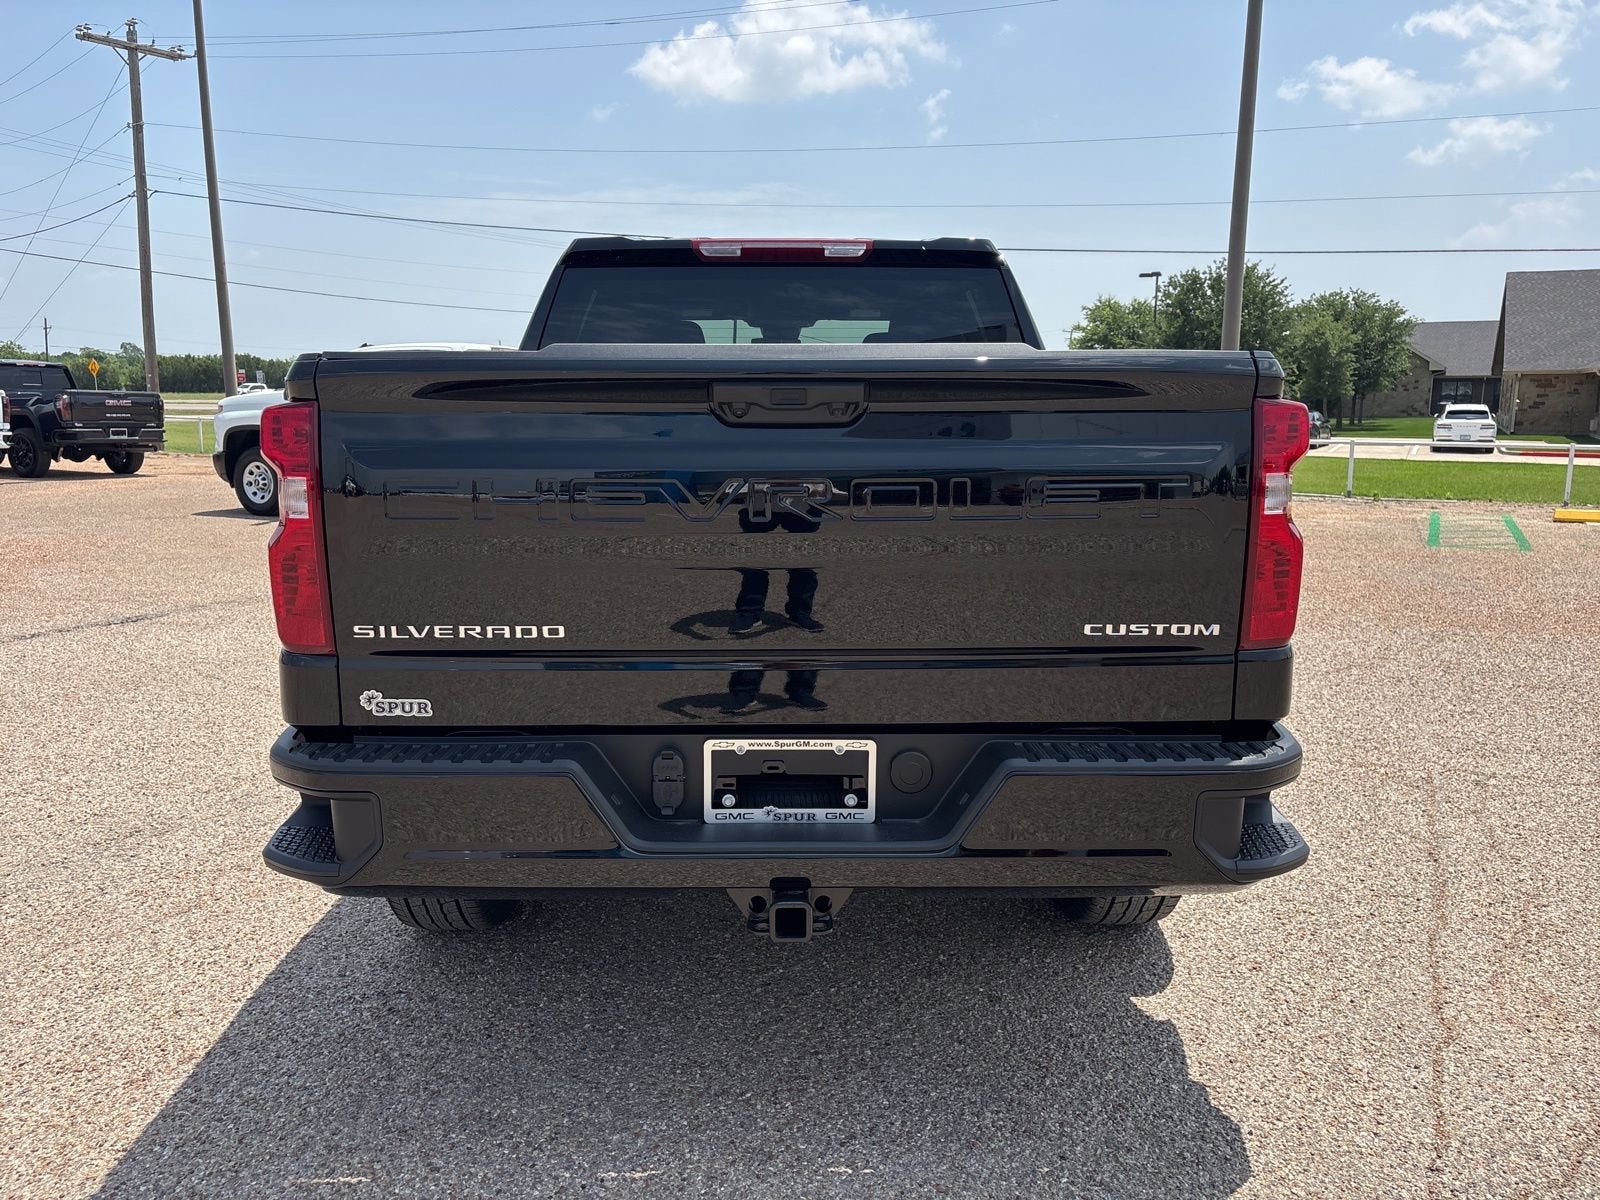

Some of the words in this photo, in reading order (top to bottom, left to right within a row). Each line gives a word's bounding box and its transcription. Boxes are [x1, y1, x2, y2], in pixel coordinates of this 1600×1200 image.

[382, 475, 1191, 522] CHEVROLET
[352, 625, 565, 639] SILVERADO
[1083, 623, 1221, 636] CUSTOM
[375, 701, 431, 714] SPUR
[747, 740, 833, 749] www.SpurGM.com
[714, 812, 755, 820] GMC
[772, 812, 817, 821] SPUR
[825, 812, 865, 820] GMC
